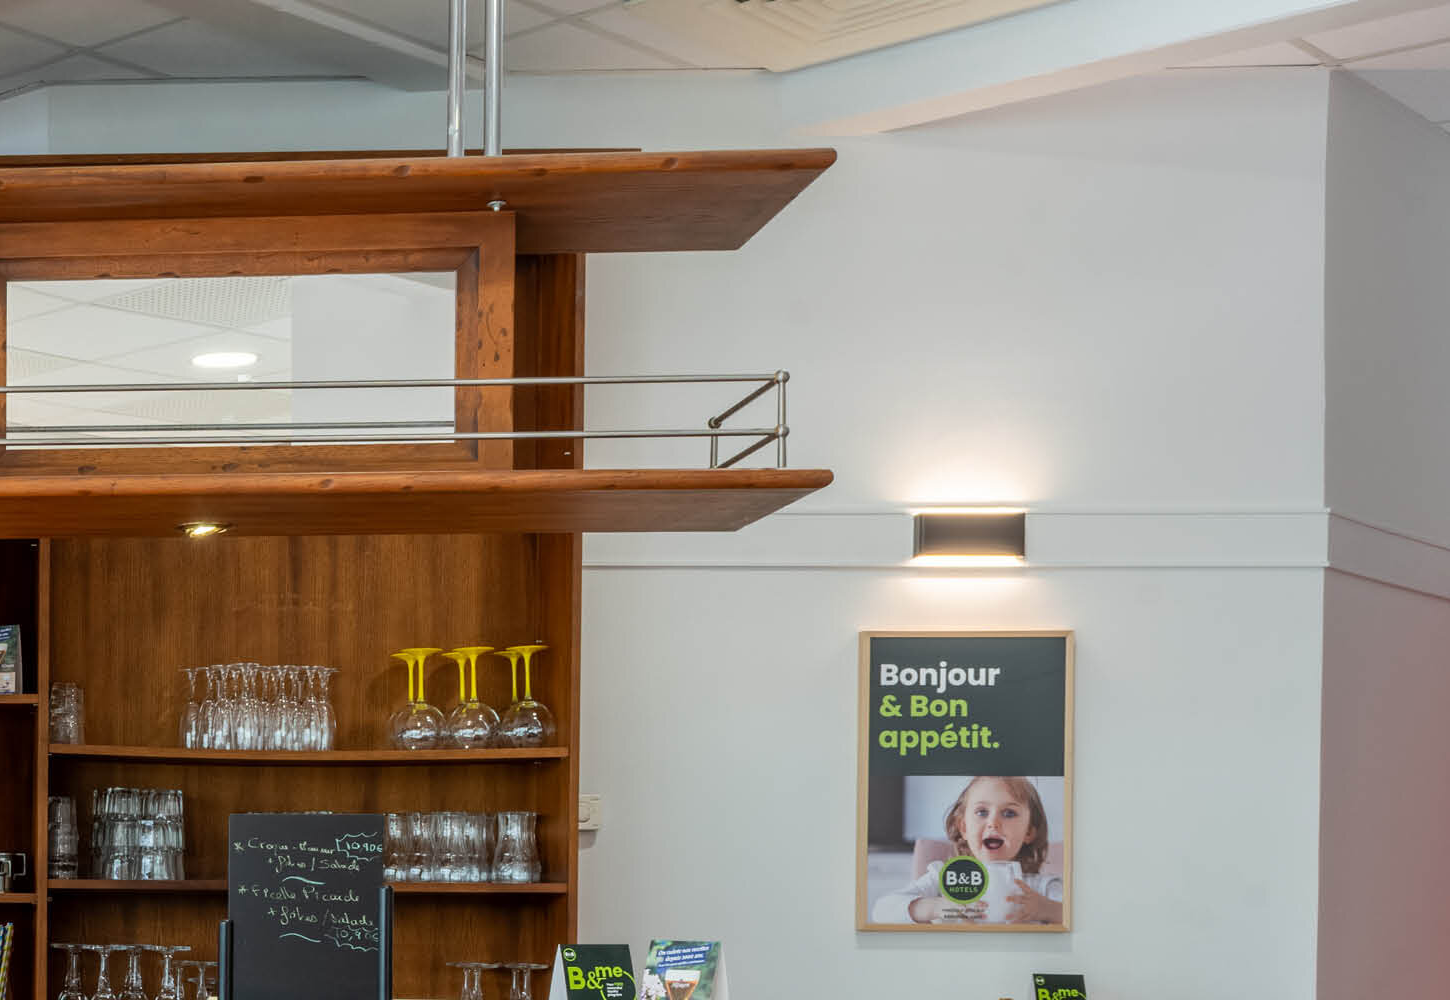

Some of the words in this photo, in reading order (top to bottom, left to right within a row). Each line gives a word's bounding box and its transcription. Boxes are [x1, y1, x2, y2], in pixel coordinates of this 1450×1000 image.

[879, 661, 1000, 693] Bonjour
[879, 694, 902, 717] &
[910, 695, 968, 717] Bon
[878, 723, 1000, 756] appétit.
[946, 870, 983, 885] B&B
